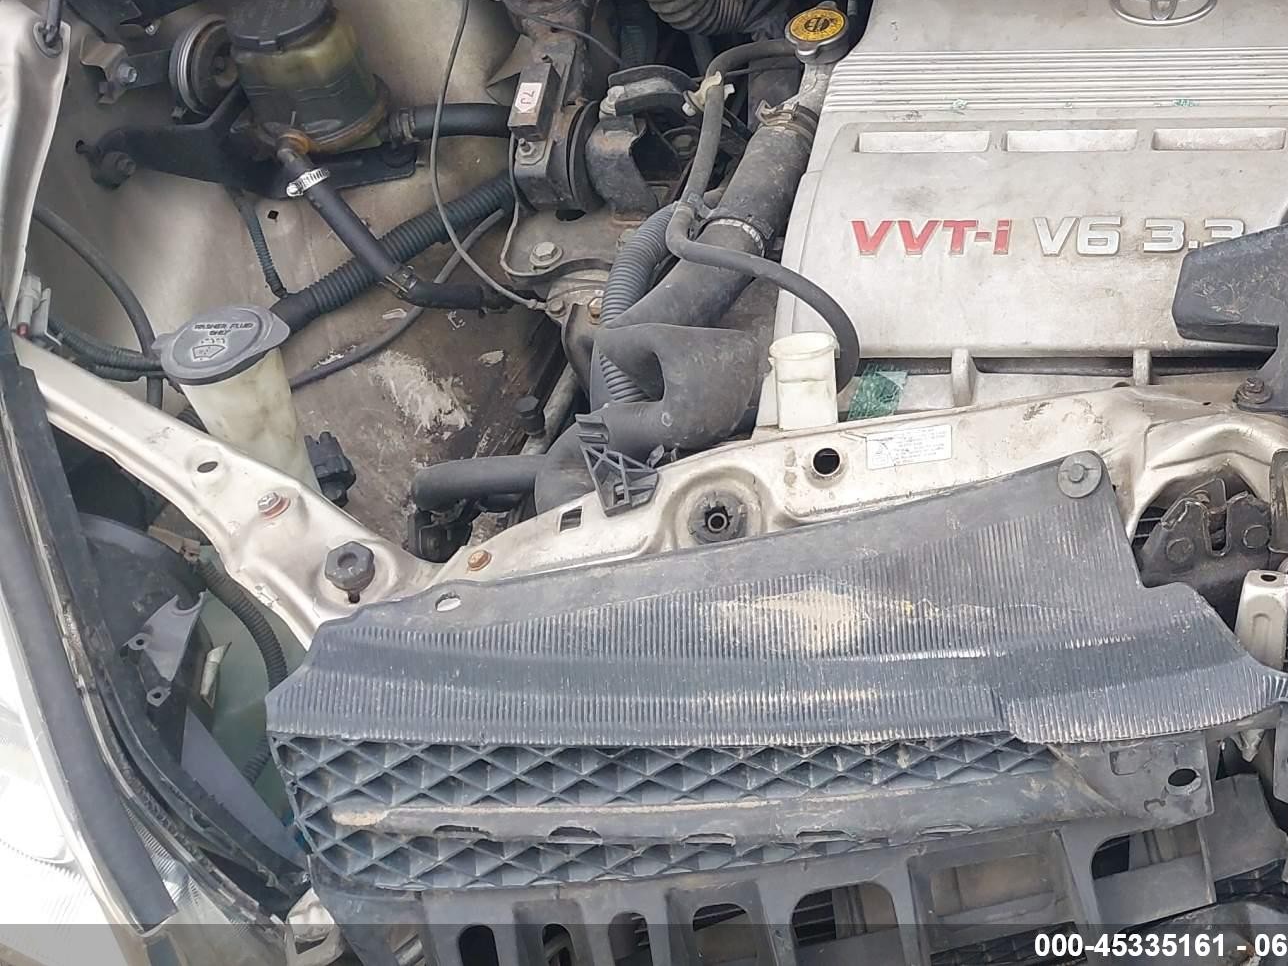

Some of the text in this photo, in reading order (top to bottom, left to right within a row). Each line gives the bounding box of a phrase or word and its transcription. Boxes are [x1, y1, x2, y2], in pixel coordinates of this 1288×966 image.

[850, 216, 1246, 257] VVT-i V6 3.3
